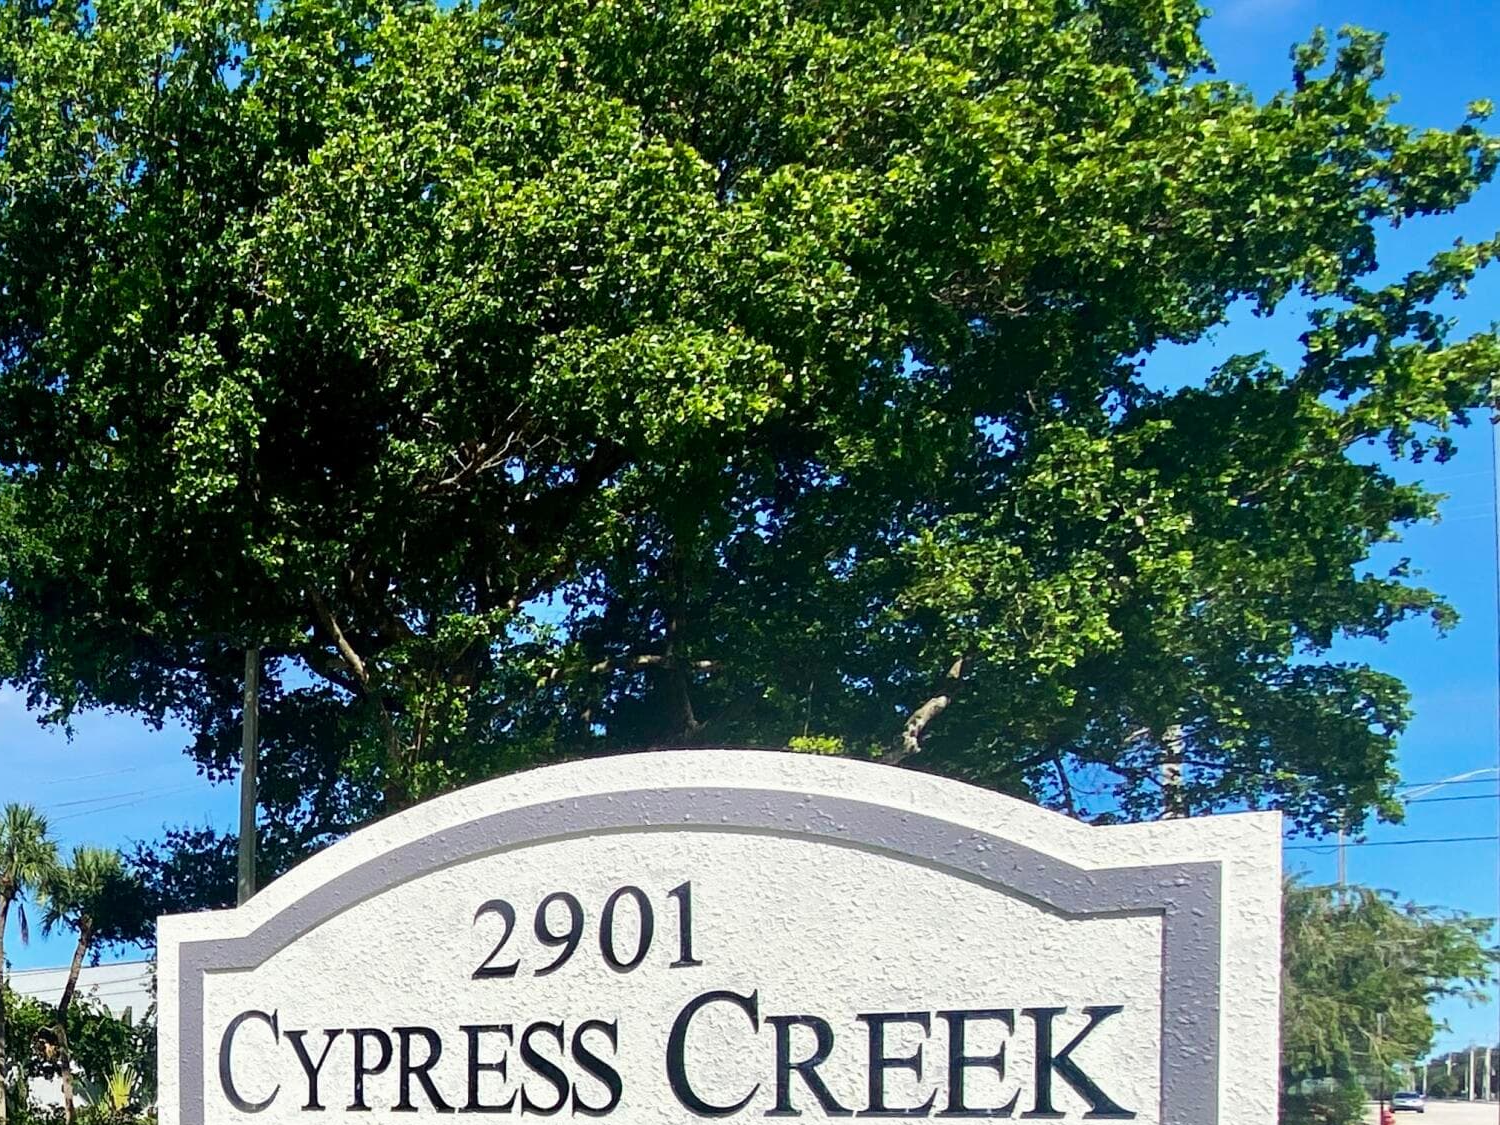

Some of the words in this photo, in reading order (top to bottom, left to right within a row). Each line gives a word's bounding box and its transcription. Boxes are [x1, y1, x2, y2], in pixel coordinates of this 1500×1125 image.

[471, 880, 703, 981] 2901
[218, 1008, 624, 1118] CYPRESS
[665, 987, 1137, 1121] CREEK
